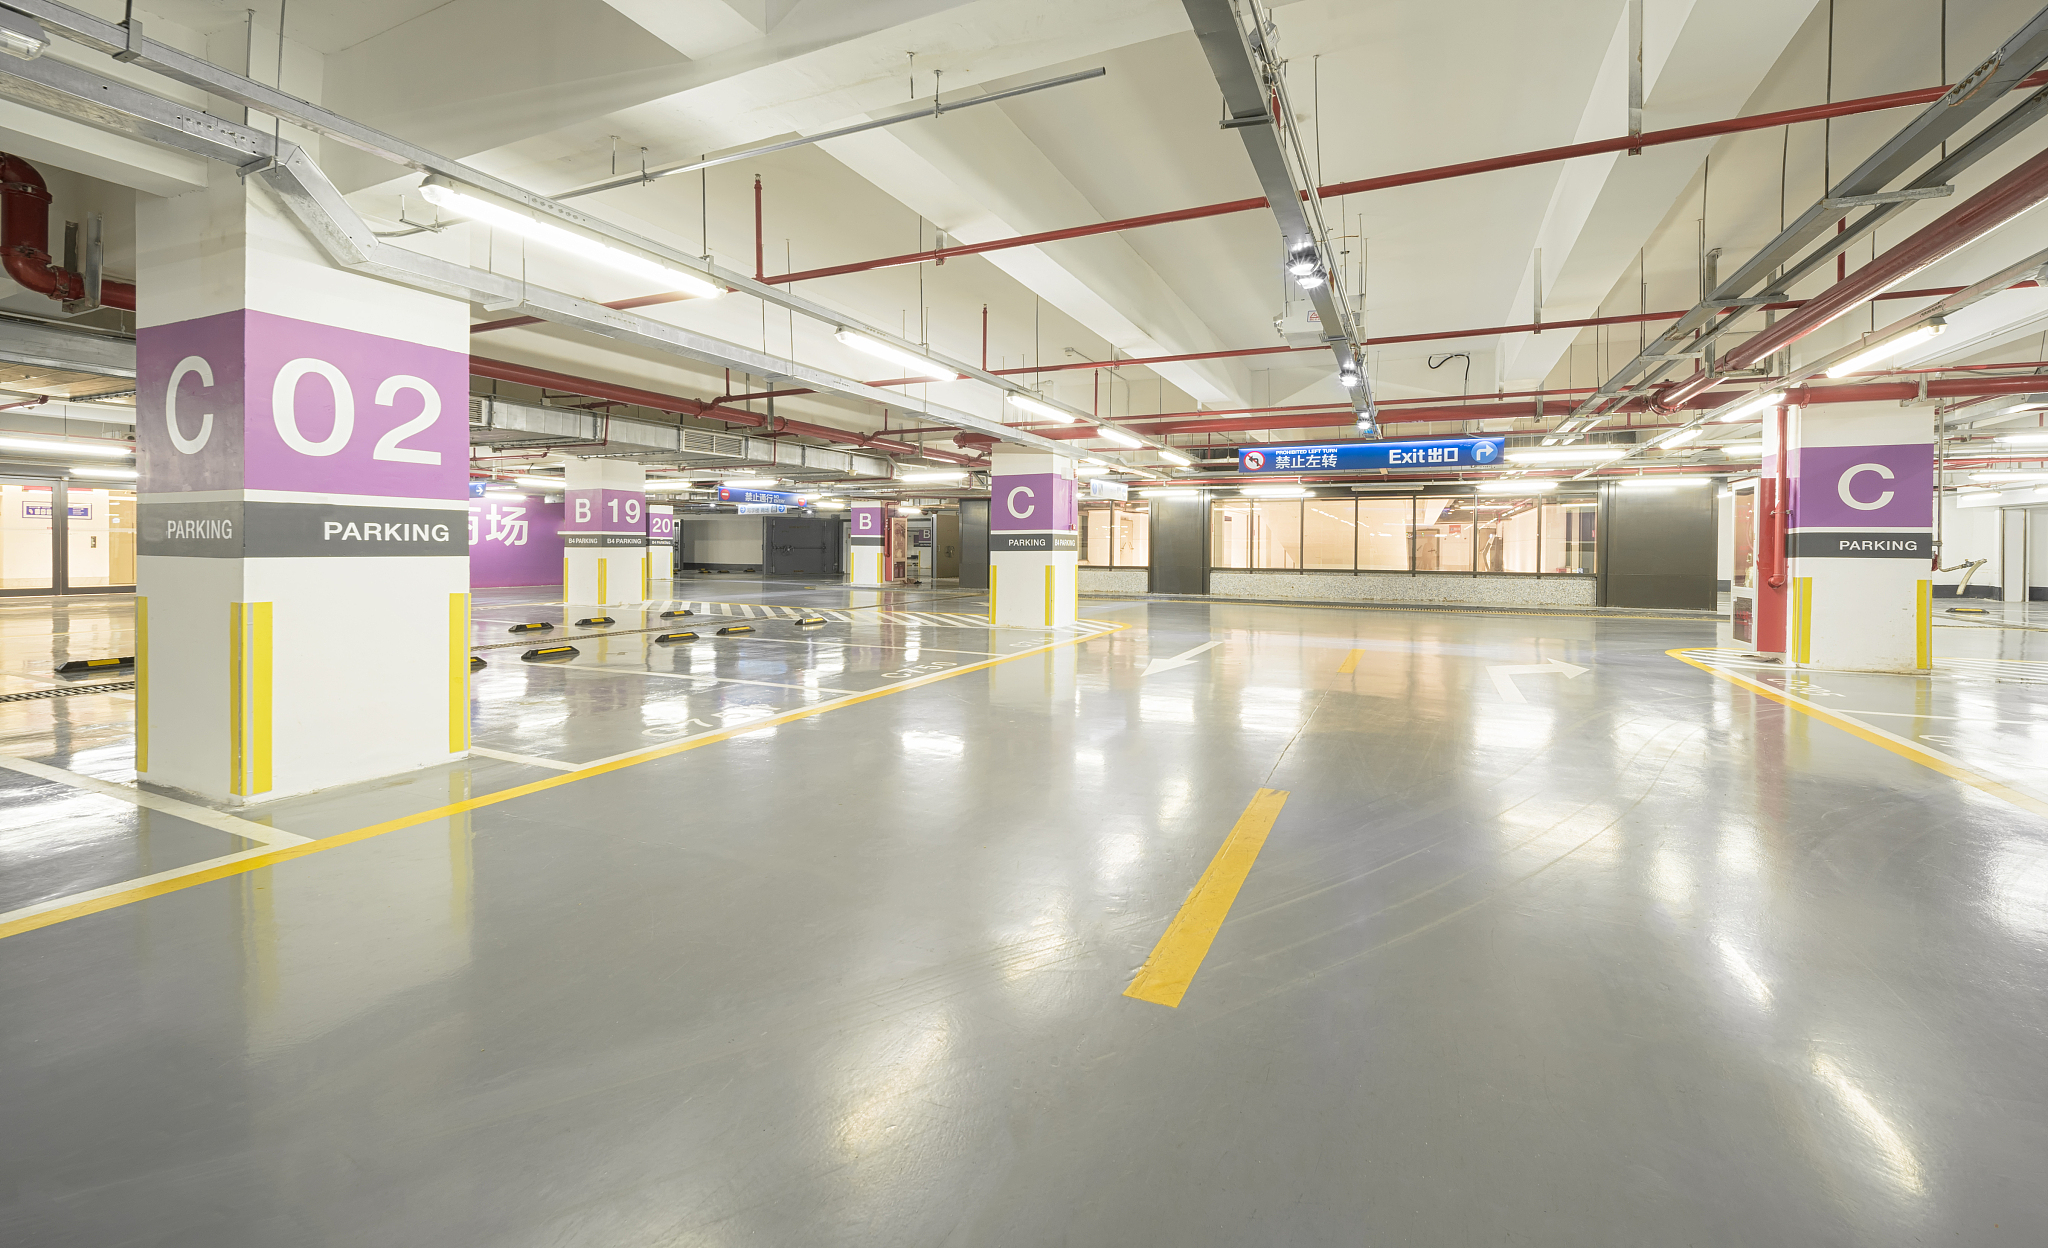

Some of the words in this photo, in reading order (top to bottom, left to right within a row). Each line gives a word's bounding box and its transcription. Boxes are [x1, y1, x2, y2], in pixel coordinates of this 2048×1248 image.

[165, 355, 215, 455] C
[271, 357, 442, 466] 02
[1275, 454, 1338, 469] 禁止左转
[1388, 448, 1426, 464] Exit
[1428, 447, 1459, 463] 出口
[1837, 463, 1895, 511] C
[744, 492, 774, 503] 禁止通行
[1007, 486, 1035, 519] C
[575, 498, 592, 523] B
[607, 498, 641, 524] 19
[167, 519, 233, 540] PARKING
[652, 517, 671, 533] 20
[859, 512, 872, 530] B
[323, 521, 450, 542] PARKING
[923, 529, 931, 539] B
[1008, 538, 1046, 547] PARKING
[1839, 540, 1918, 551] PARKING
